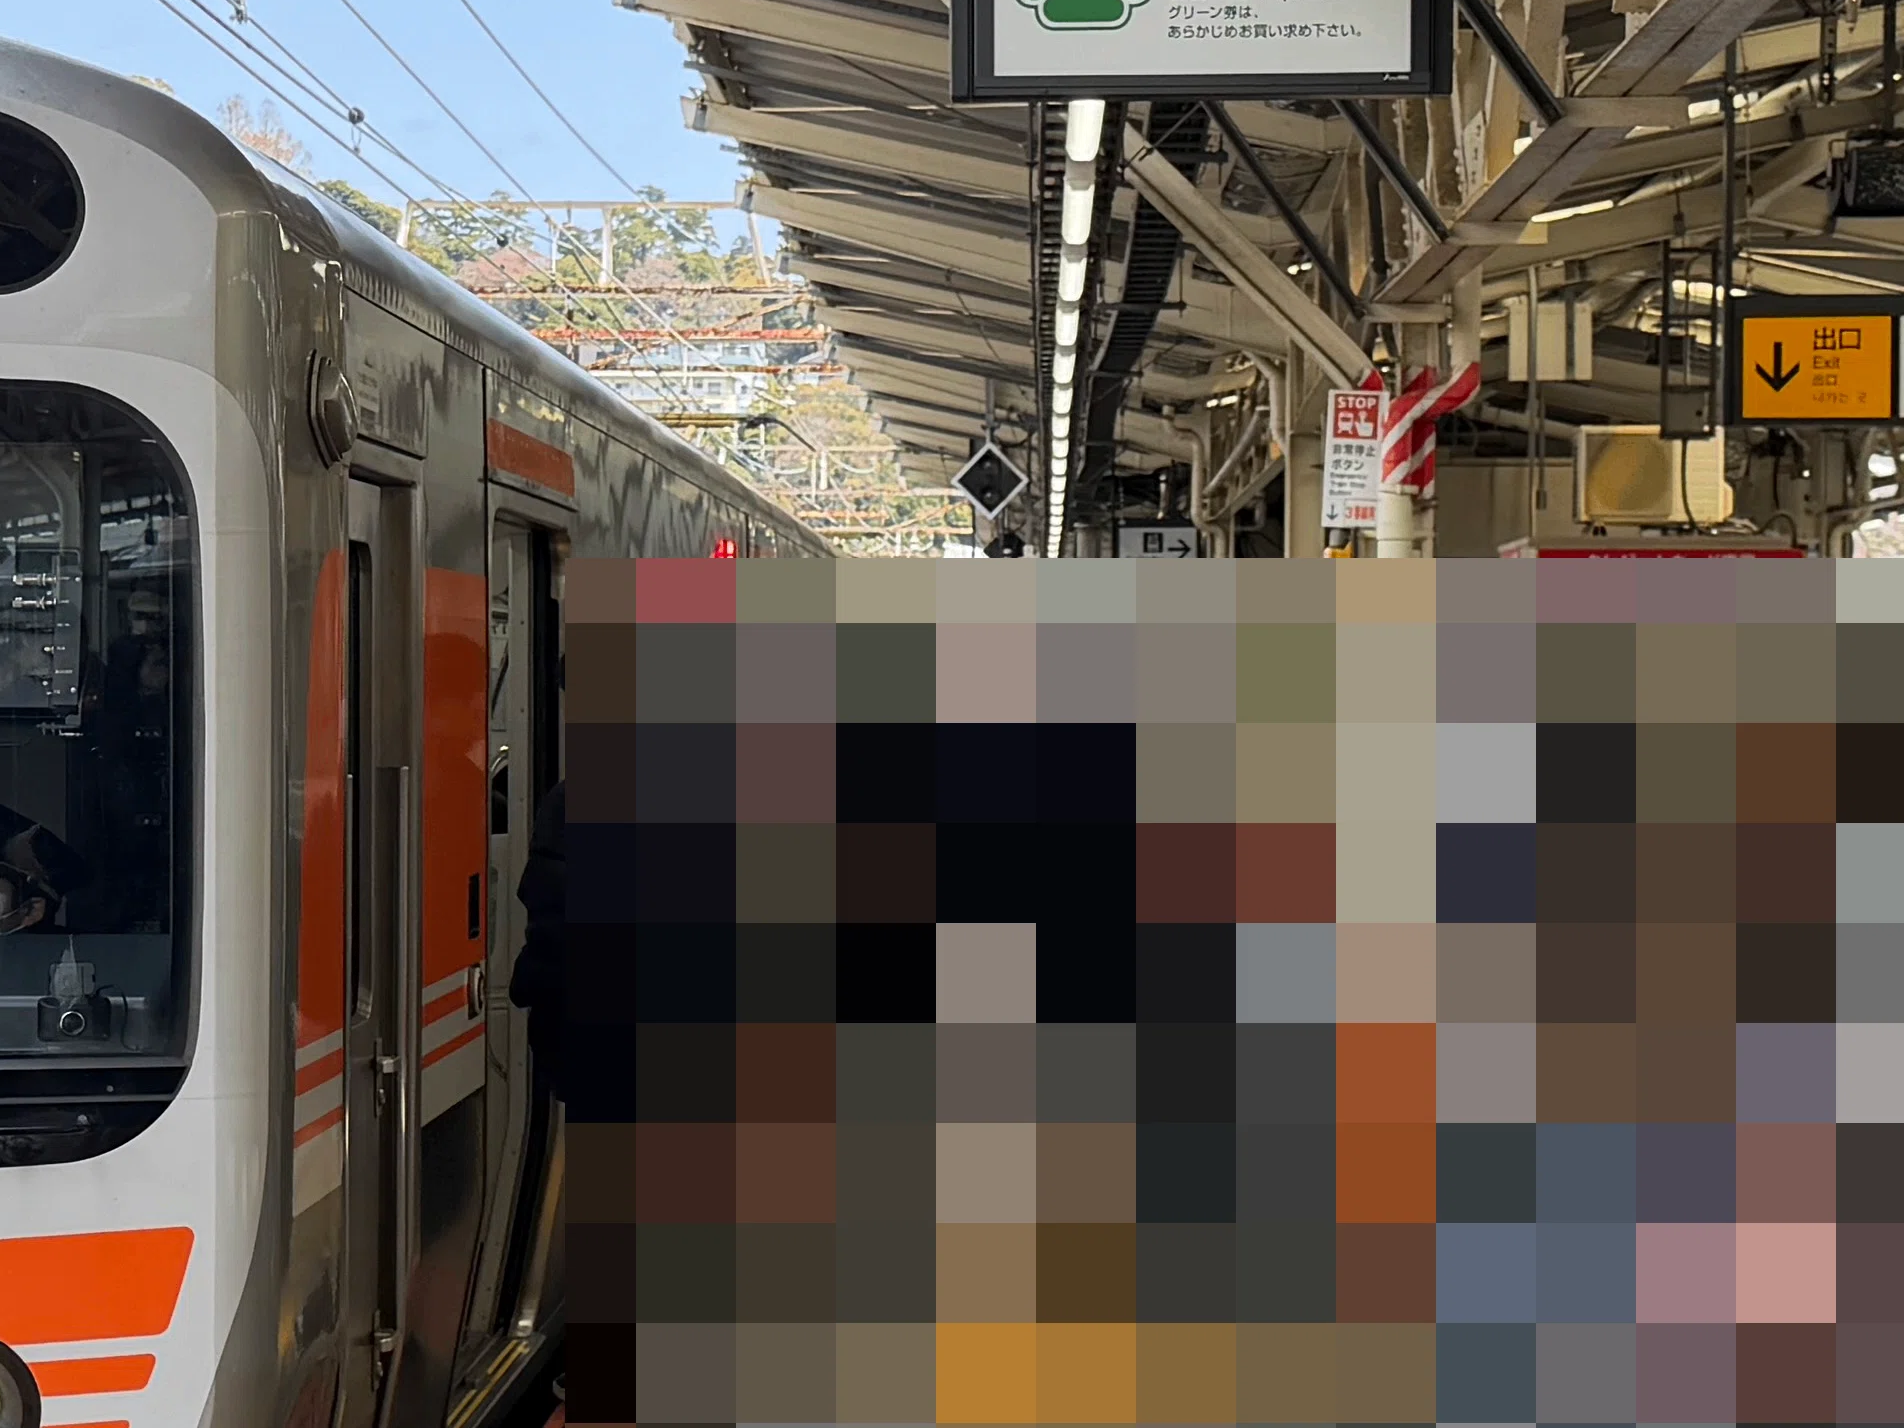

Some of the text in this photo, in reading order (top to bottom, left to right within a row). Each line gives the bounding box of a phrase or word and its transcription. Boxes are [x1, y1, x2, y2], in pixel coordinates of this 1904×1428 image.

[1167, 24, 1362, 39] あらかじめお買い求め下さい。
[1813, 326, 1861, 351] 出口
[1813, 355, 1840, 369] Exit
[1337, 396, 1377, 409] STOP
[1331, 458, 1364, 471] ボタン
